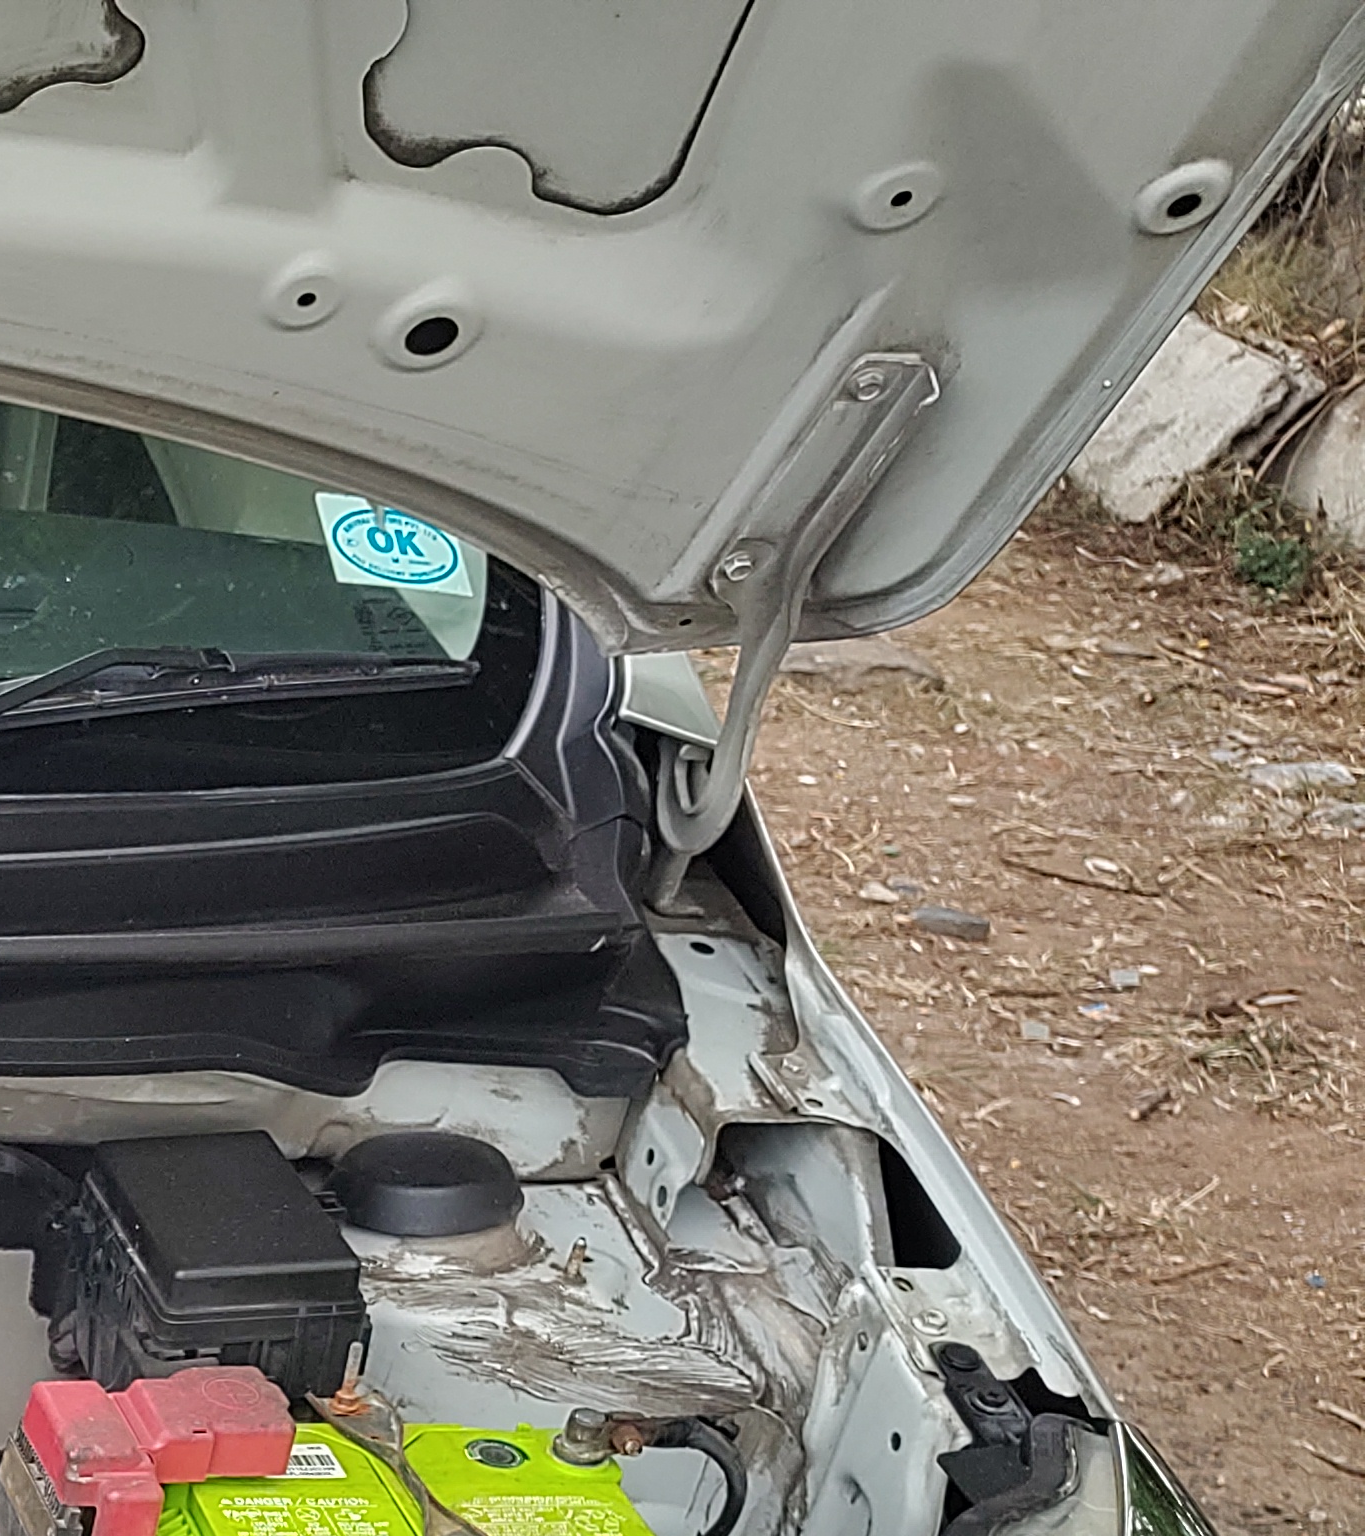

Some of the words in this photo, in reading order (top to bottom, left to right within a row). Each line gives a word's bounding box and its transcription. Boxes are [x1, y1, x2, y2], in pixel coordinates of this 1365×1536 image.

[367, 527, 424, 557] OK
[234, 1497, 293, 1506] DANGER
[306, 1497, 369, 1506] CAUTION
